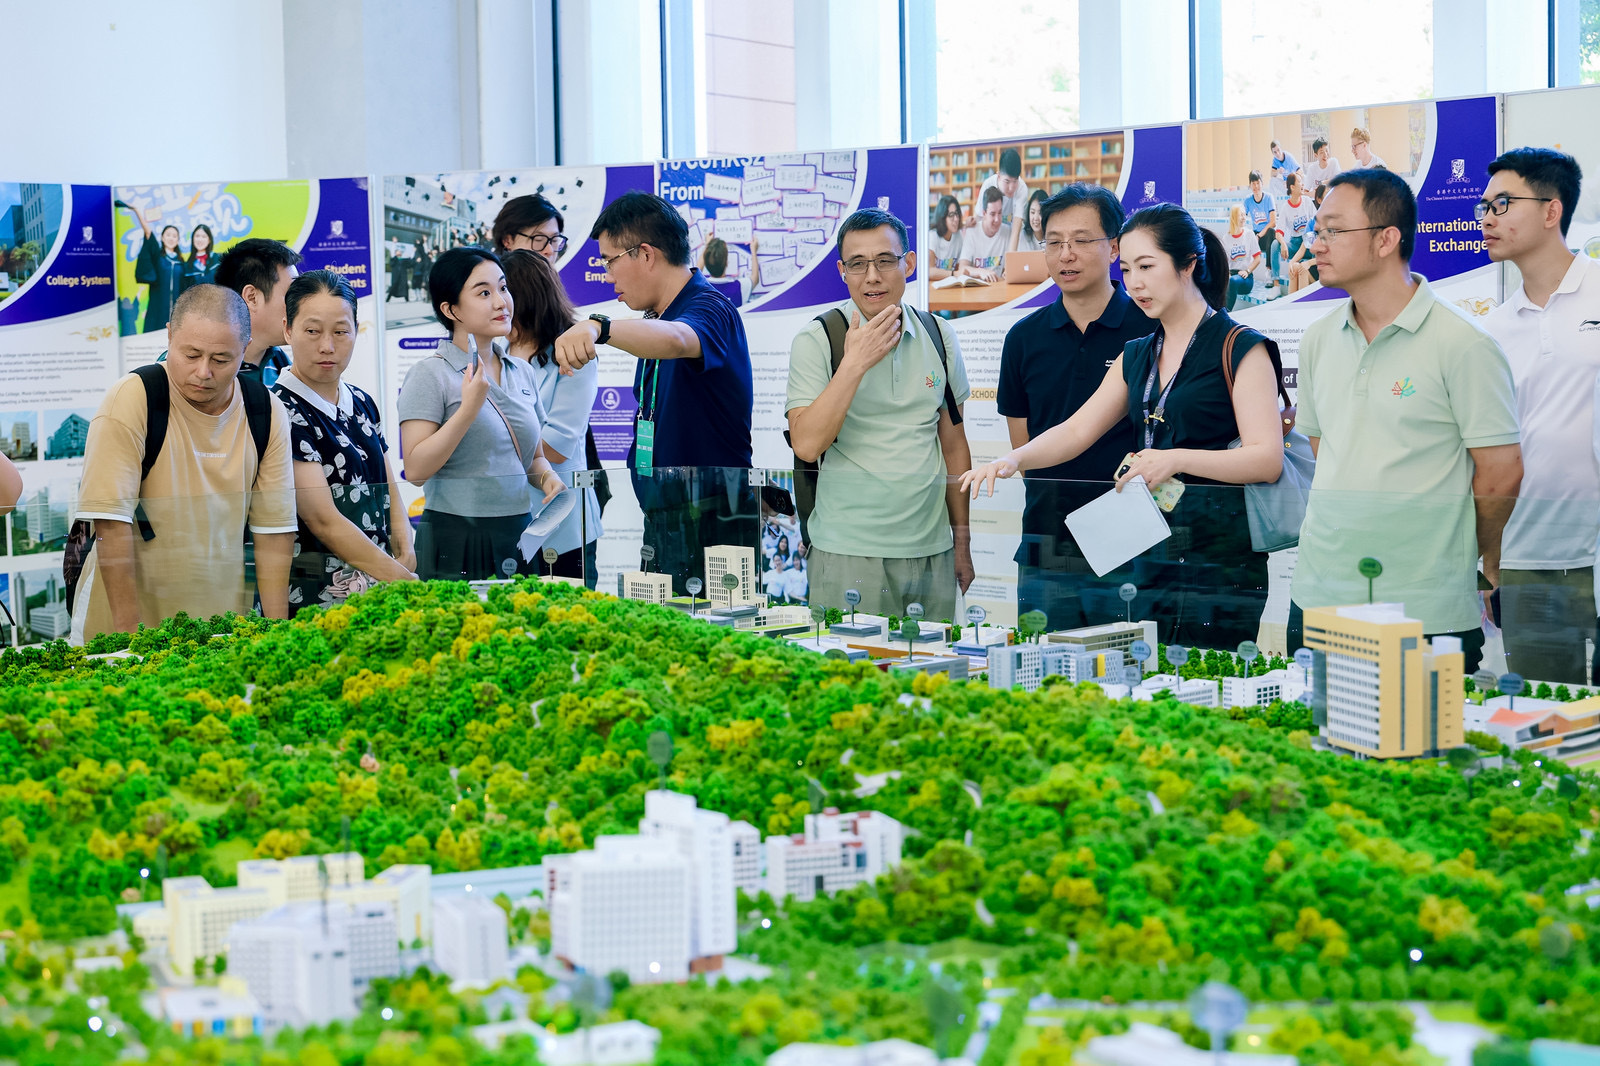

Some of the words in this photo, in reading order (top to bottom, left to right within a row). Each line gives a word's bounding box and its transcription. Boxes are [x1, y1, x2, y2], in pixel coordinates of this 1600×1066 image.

[660, 181, 705, 201] From
[1417, 218, 1483, 233] nternationa
[1429, 238, 1488, 253] Exchange
[324, 264, 366, 274] Student
[46, 275, 79, 288] College
[81, 275, 111, 287] System
[1284, 374, 1294, 384] of
